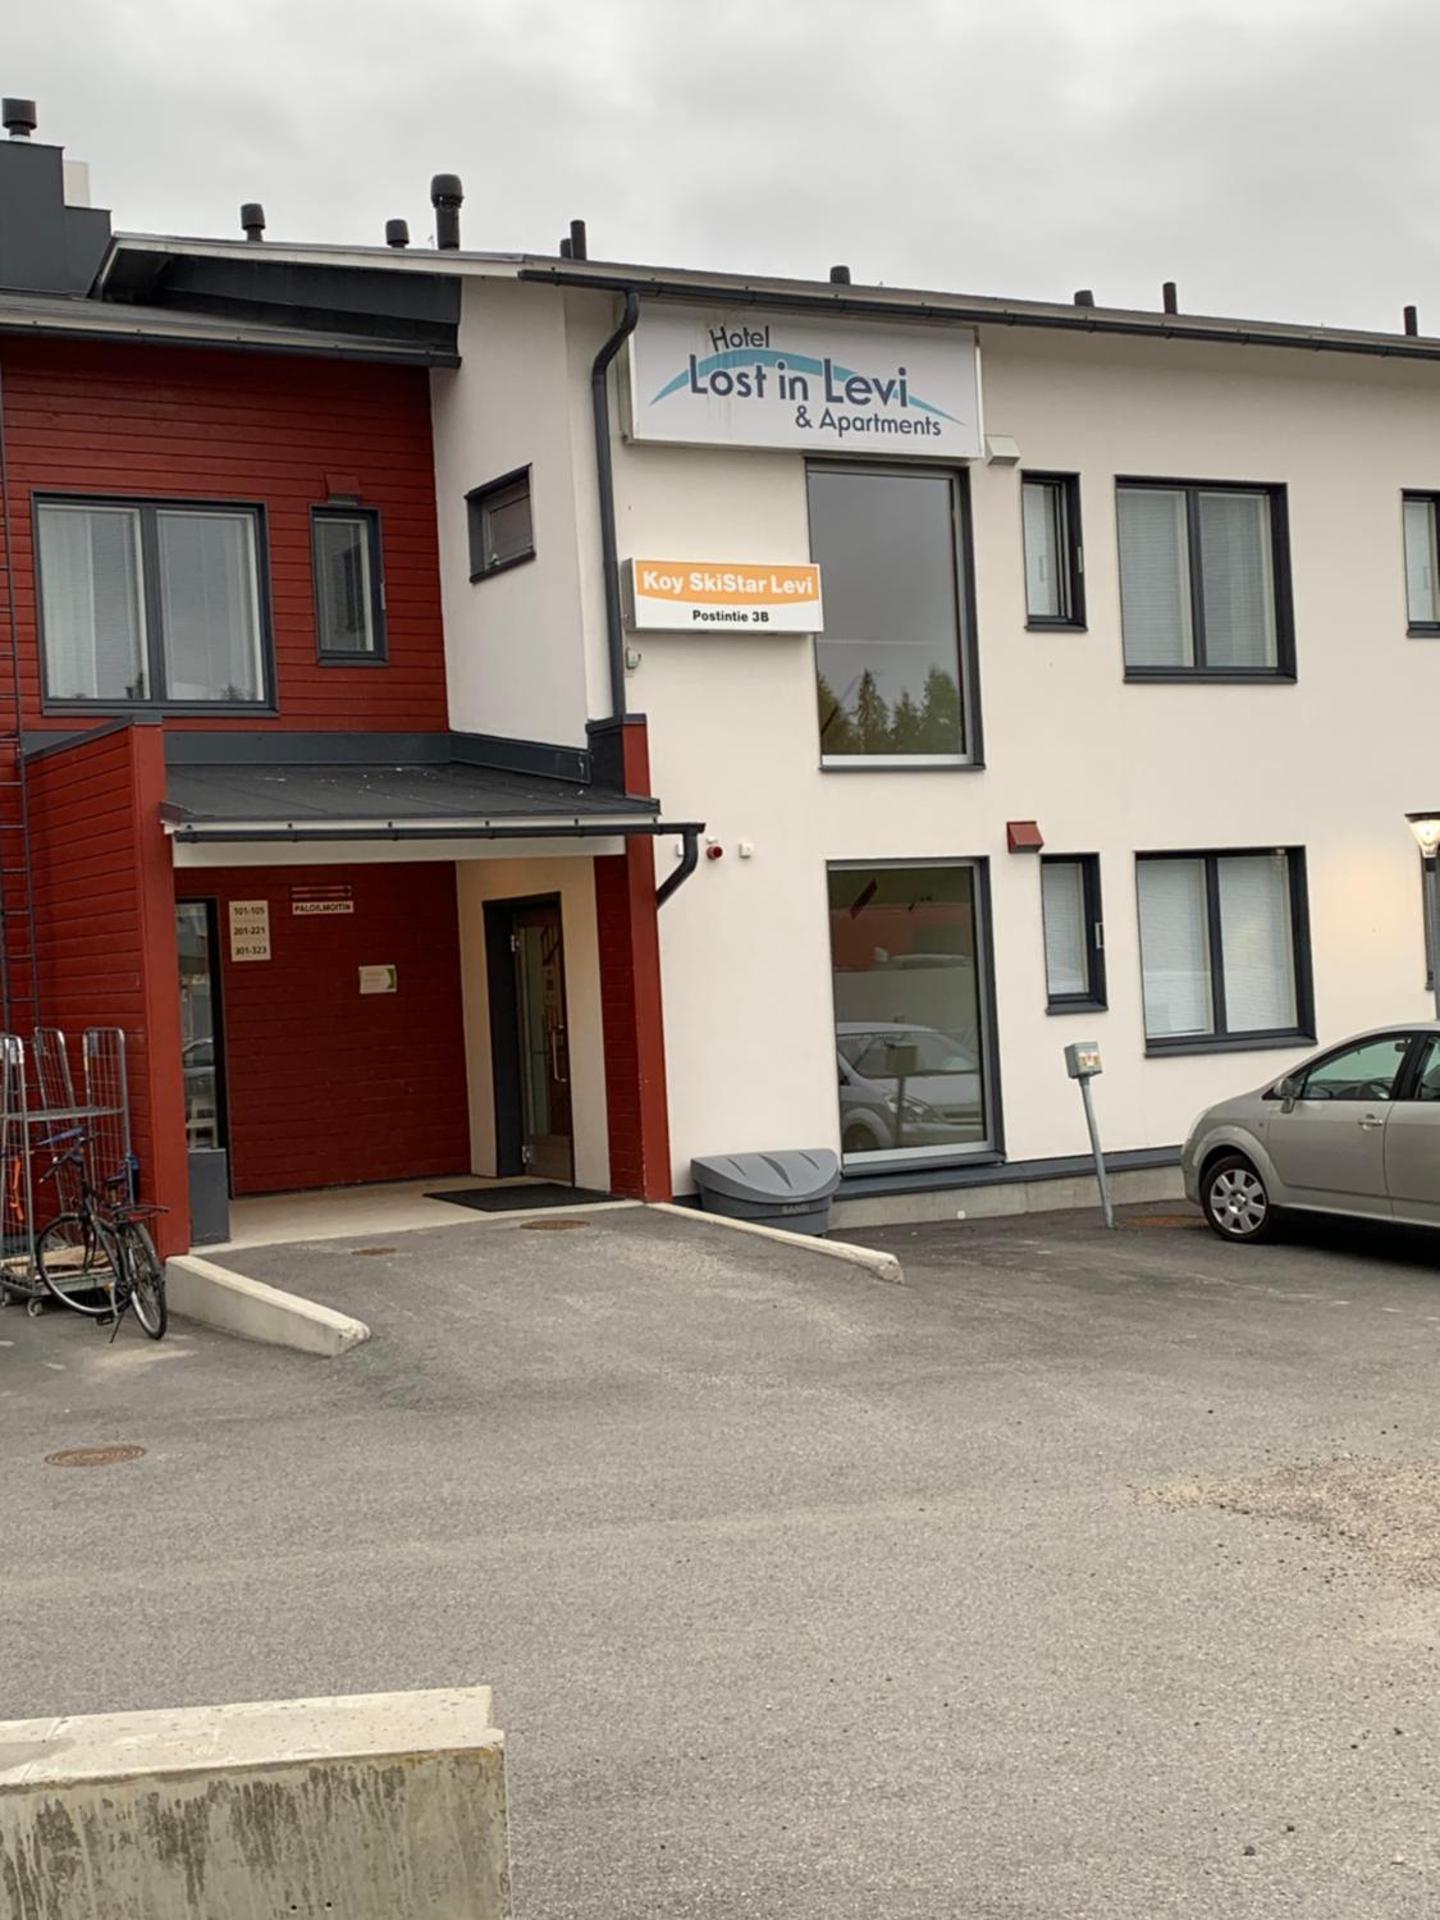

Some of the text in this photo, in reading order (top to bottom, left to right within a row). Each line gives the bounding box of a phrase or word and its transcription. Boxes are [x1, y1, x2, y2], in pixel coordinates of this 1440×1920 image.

[709, 326, 770, 352] Hotel
[690, 354, 907, 408] Lost in Levi
[795, 405, 941, 437] & Apartments
[643, 571, 812, 594] Koy SkiStar Levi
[693, 610, 769, 622] Postintie 3B
